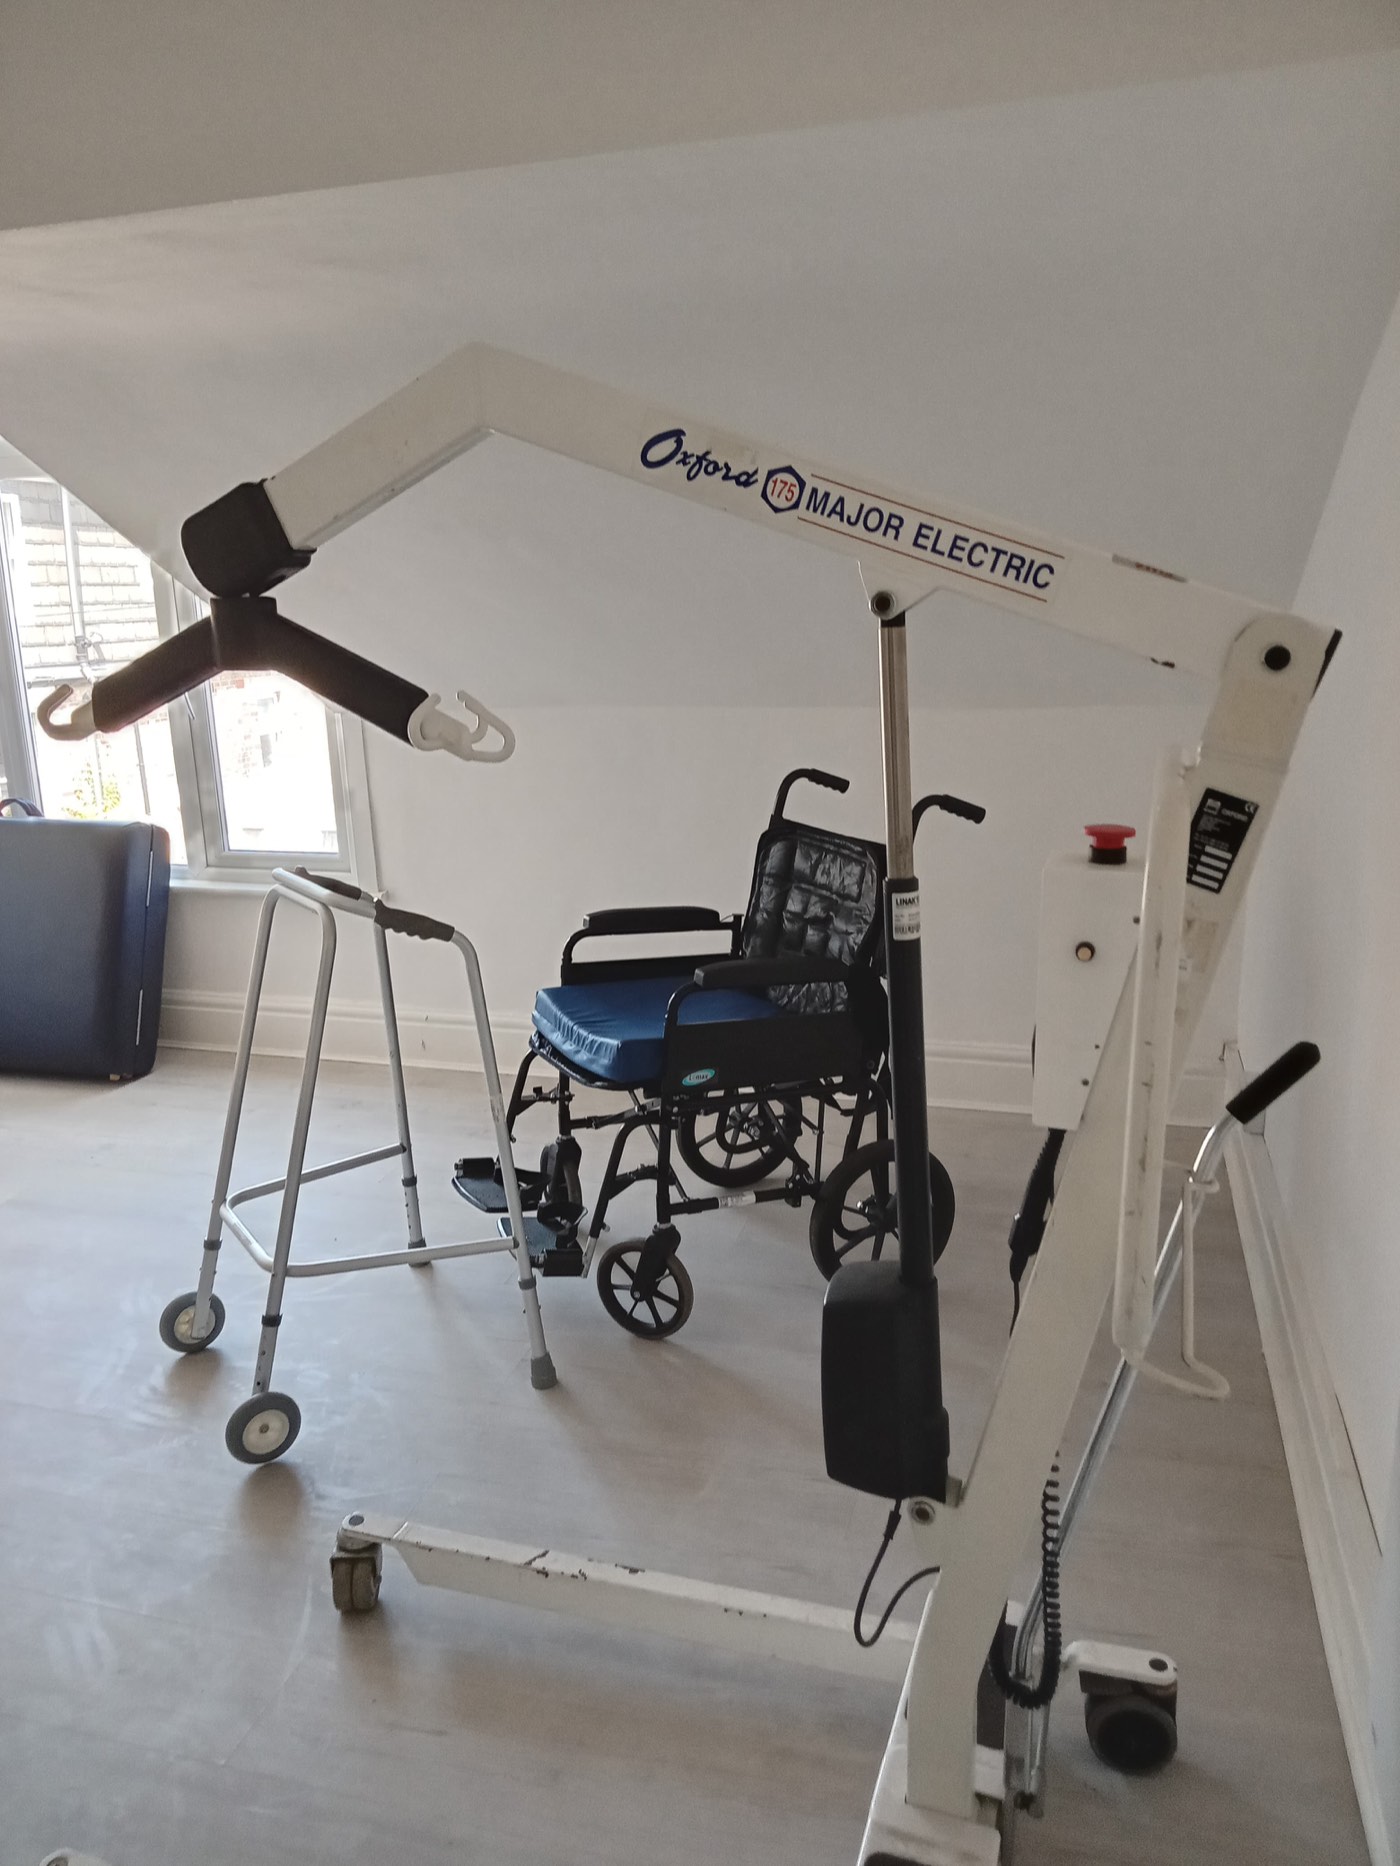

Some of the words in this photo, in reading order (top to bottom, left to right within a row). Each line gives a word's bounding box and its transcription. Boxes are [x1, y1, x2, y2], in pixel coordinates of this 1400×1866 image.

[640, 428, 759, 488] Oxford
[769, 477, 797, 502] 175
[806, 486, 904, 541] MAJOR
[911, 522, 1055, 590] ELECTRIC
